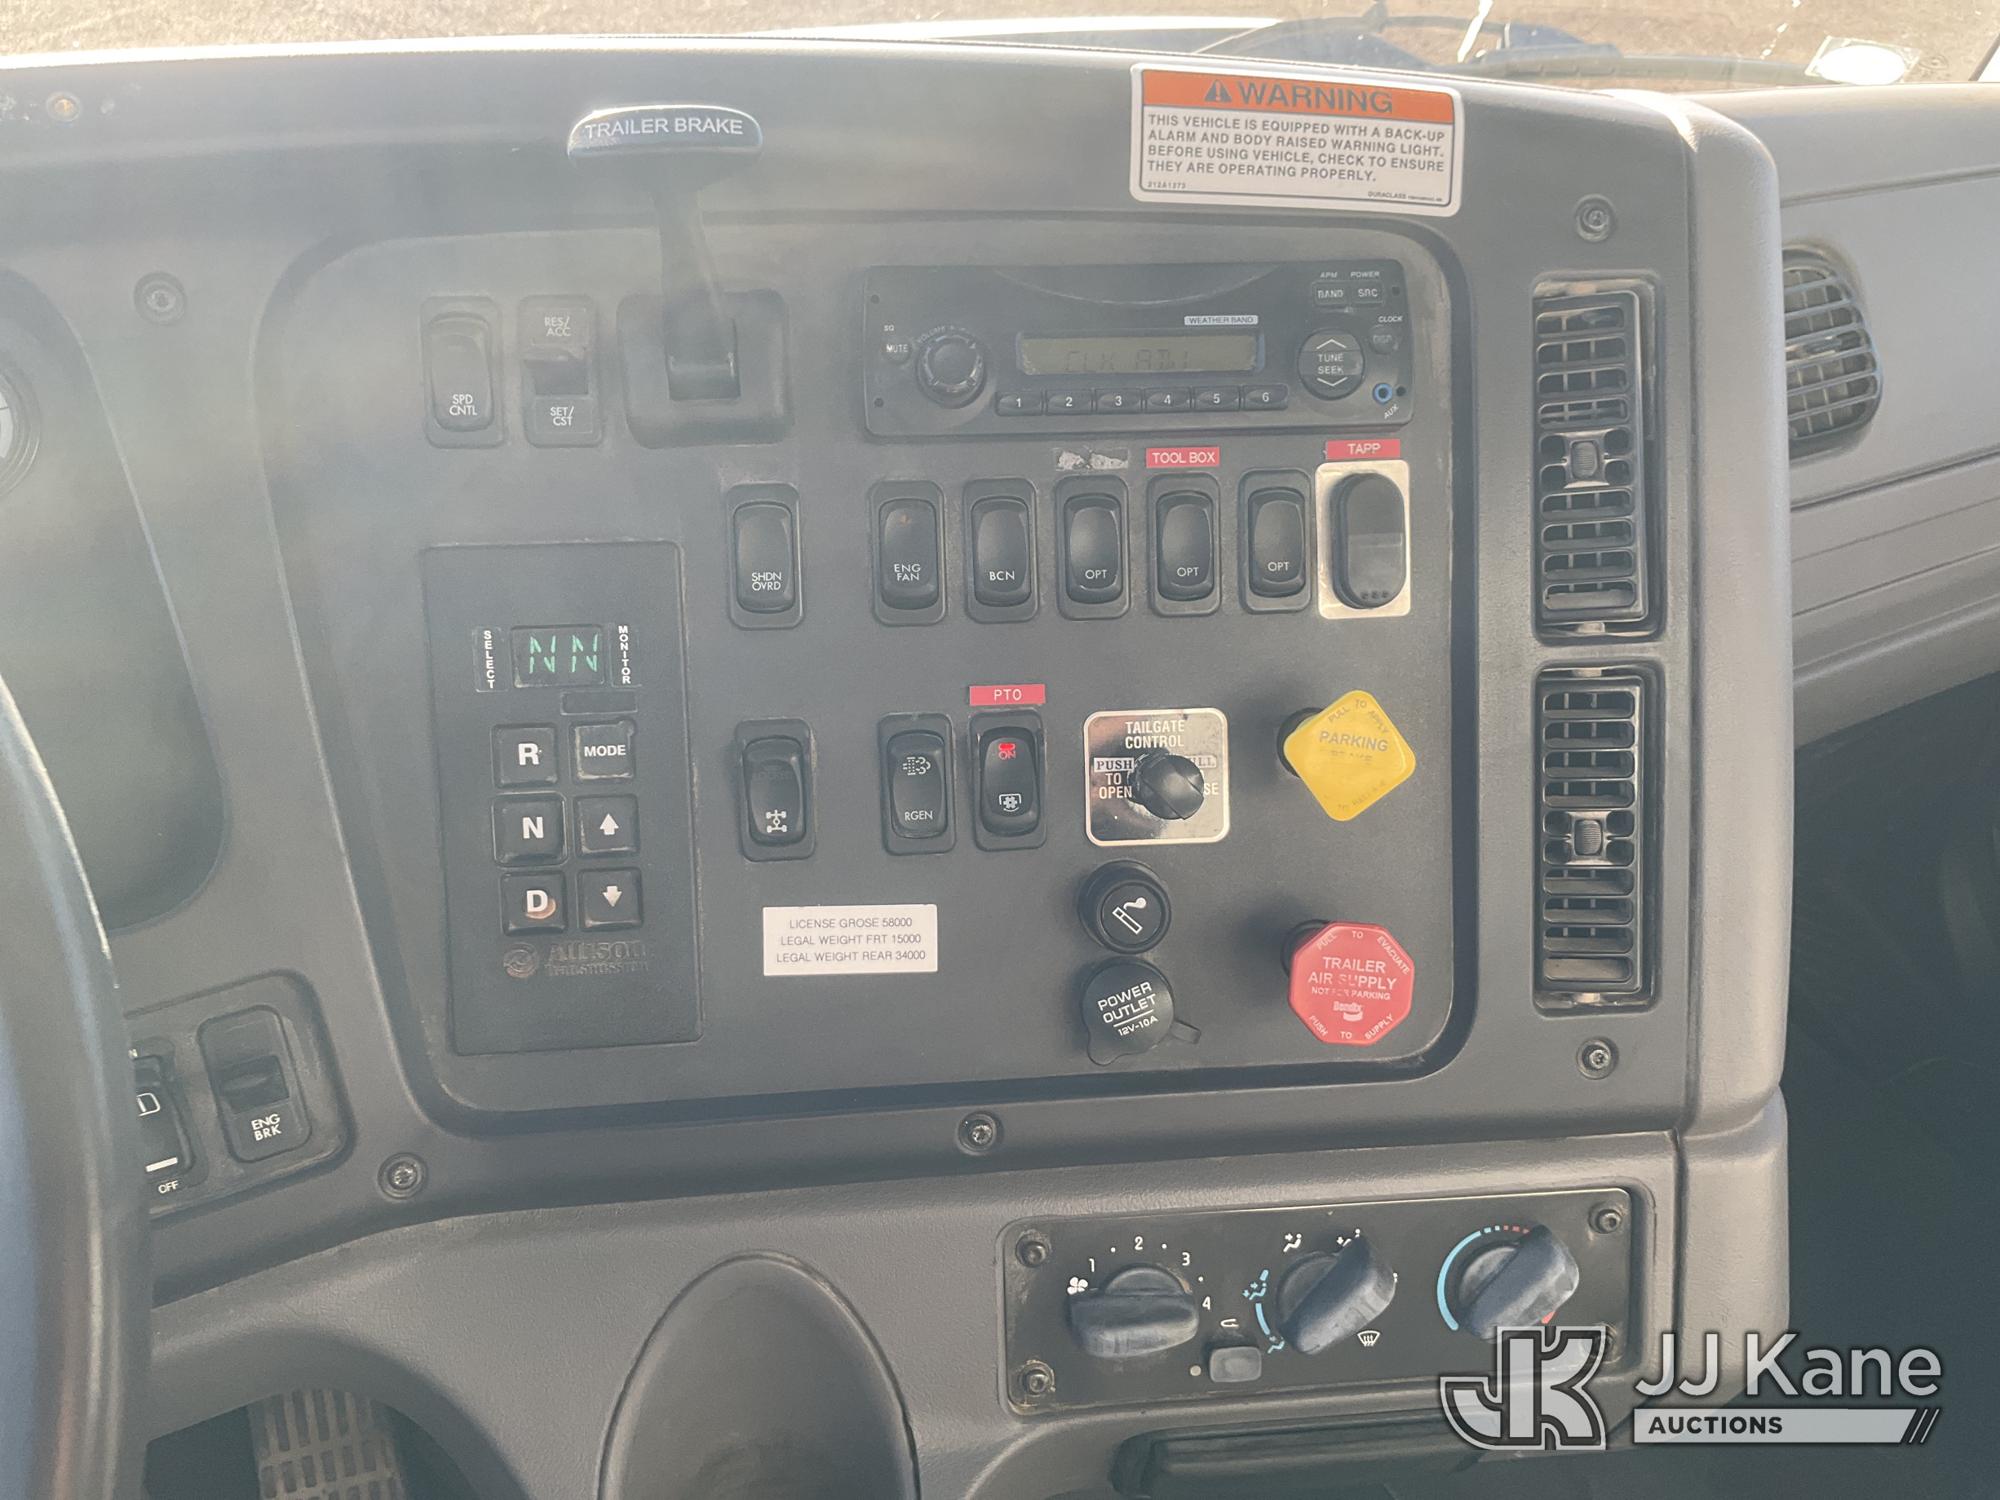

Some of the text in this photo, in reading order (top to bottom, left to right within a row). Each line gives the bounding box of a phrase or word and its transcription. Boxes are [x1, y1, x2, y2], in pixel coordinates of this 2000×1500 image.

[1236, 80, 1393, 113] WARNING
[584, 118, 744, 139] TRAILER BRAKE
[1148, 114, 1446, 142] THIS VEHICLE IS EQUIPPED WITH A BACK-UP
[1148, 130, 1445, 158] ALARM AND BODY RAISED WARNING LIGHT.
[1148, 145, 1445, 172] BEFORE USING VEHICLE, CHECK TO ENSURE
[1148, 160, 1377, 182] THEY ARE OPERATING PROPERLY.
[1350, 270, 1381, 279] POWER
[1317, 288, 1344, 299] BAND
[1357, 288, 1379, 298] SRC
[544, 315, 571, 328] RES/
[1189, 316, 1254, 324] WEATHER BAND
[1377, 315, 1404, 324] CLOCK
[545, 326, 572, 337] ACC
[885, 343, 910, 354] MUTE
[1317, 353, 1344, 363] TUNE
[1317, 365, 1345, 375] SEEK
[452, 394, 474, 405] SPD
[1065, 397, 1073, 407] 2
[1115, 396, 1122, 406] 3
[1164, 394, 1171, 404] 4
[1213, 393, 1221, 403] 5
[1262, 392, 1270, 402] 6
[449, 404, 478, 417] CNTL
[550, 405, 575, 418] SET/
[1383, 404, 1400, 419] AUX
[552, 416, 573, 427] CST
[1151, 452, 1216, 464] TOOL BOX
[893, 563, 922, 574] ENG
[1084, 568, 1107, 580] OPT
[1176, 566, 1200, 578] OPT
[1267, 561, 1290, 573] OPT
[751, 571, 783, 583] SHDN
[896, 572, 920, 582] FAN
[989, 571, 1016, 581] BCN
[752, 581, 782, 592] OVRD
[483, 630, 496, 689] SELECT
[618, 625, 631, 684] MONITOR
[992, 688, 1022, 702] PTO
[1327, 699, 1391, 734] PULL TO APPLY
[1125, 719, 1185, 735] TAILGATE
[1124, 735, 1185, 750] CONTROL
[1318, 730, 1389, 752] PARKING
[517, 742, 540, 765] R
[583, 744, 627, 758] MODE
[998, 750, 1017, 760] ON
[1096, 759, 1133, 771] PUSH
[1105, 772, 1122, 786] TO
[1099, 785, 1133, 800] OPEN
[904, 810, 934, 822] RGEN
[522, 816, 544, 839] N
[525, 889, 549, 913] D
[789, 917, 913, 929] LICENSE GROSE 58000
[780, 933, 921, 946] LEGAL WEIGHT FRT 15000
[776, 950, 926, 963] LEGAL WEIGHT REAR 34000
[1316, 930, 1411, 975] PULL TO EVACUATE
[1322, 956, 1387, 974] TRAILER
[1307, 971, 1398, 990] AIR SUPPLY
[1097, 981, 1153, 1012] POWER
[1311, 986, 1329, 995] NOT
[1351, 988, 1392, 1001] PARKING
[1102, 993, 1156, 1024] OUTLET
[1117, 1014, 1159, 1037] 12V-10A
[1308, 1012, 1394, 1040] PUSH TO SUPPLY
[251, 1112, 281, 1131] ENG
[253, 1124, 282, 1142] BRK
[158, 1179, 179, 1194] OFF
[1134, 1236, 1143, 1250] 2
[1088, 1258, 1095, 1273] 1
[1181, 1251, 1191, 1266] 3
[1202, 1296, 1211, 1310] 4
